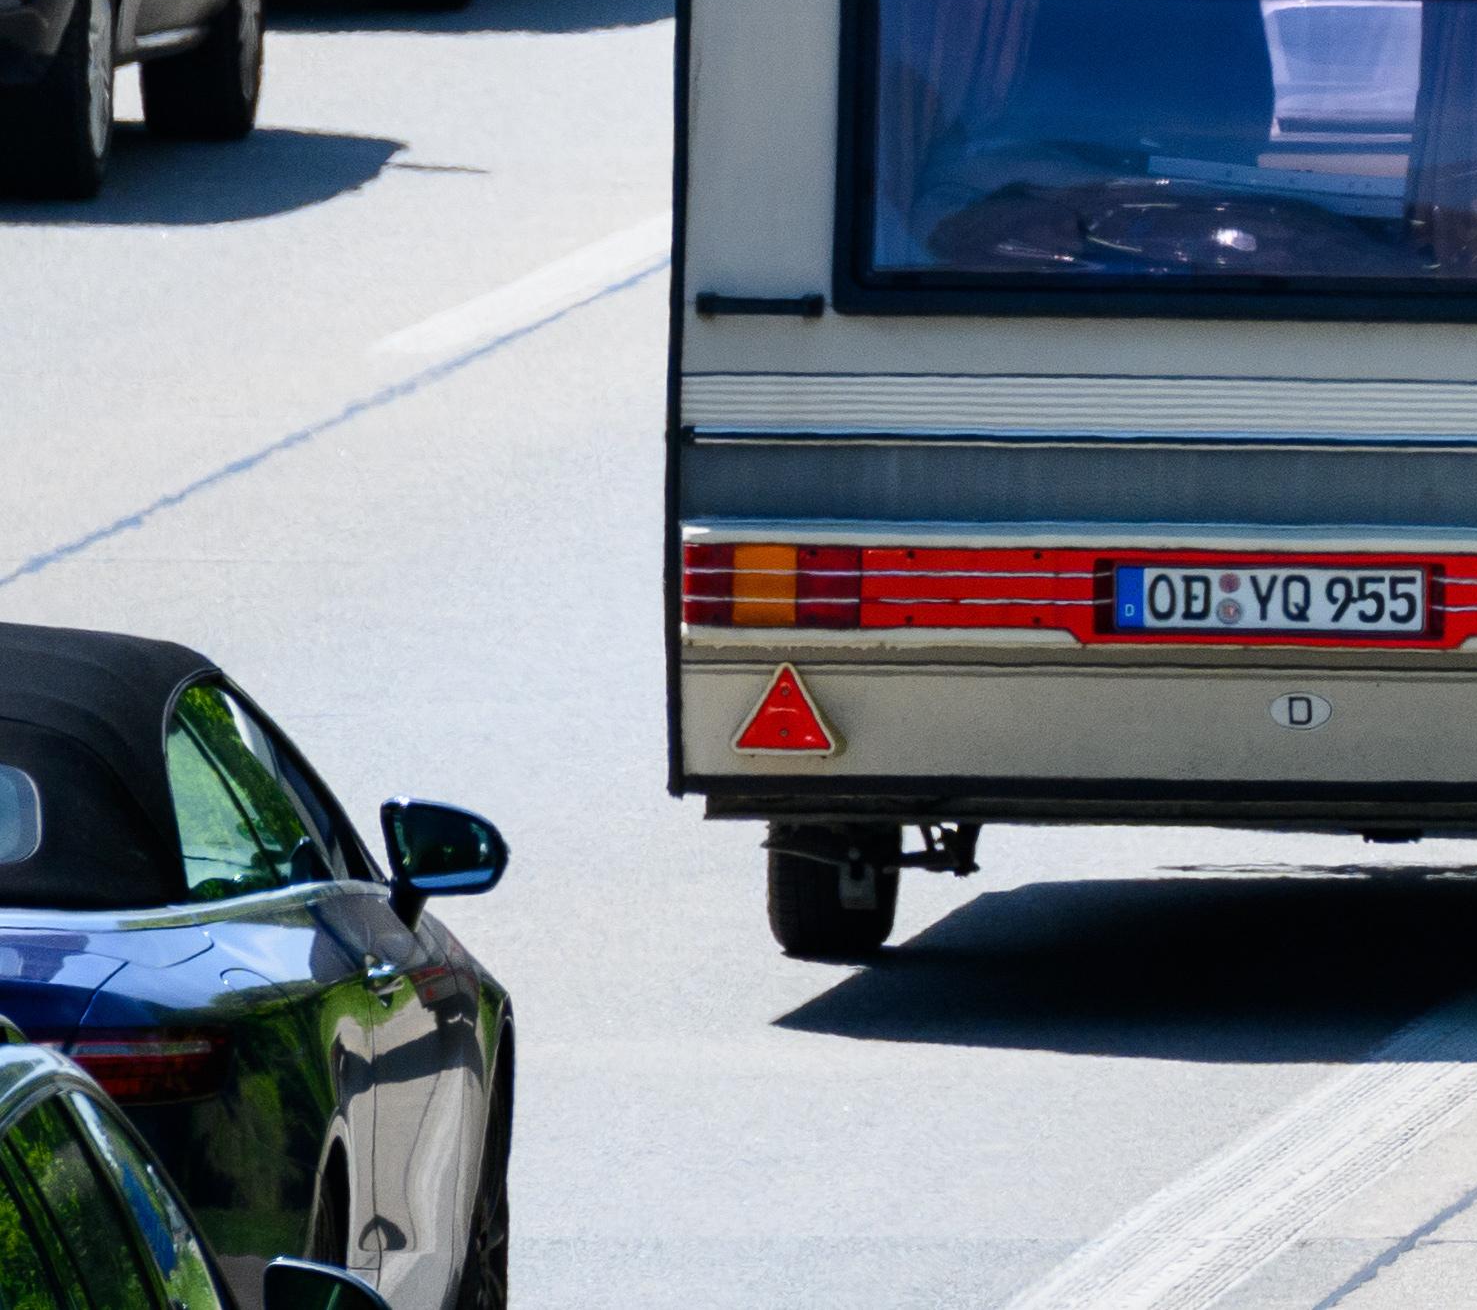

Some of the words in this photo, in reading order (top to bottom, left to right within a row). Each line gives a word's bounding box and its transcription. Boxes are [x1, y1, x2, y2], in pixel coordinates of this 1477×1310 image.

[1250, 575, 1310, 622] YQ
[1325, 576, 1417, 624] 955
[1288, 695, 1313, 727] D
